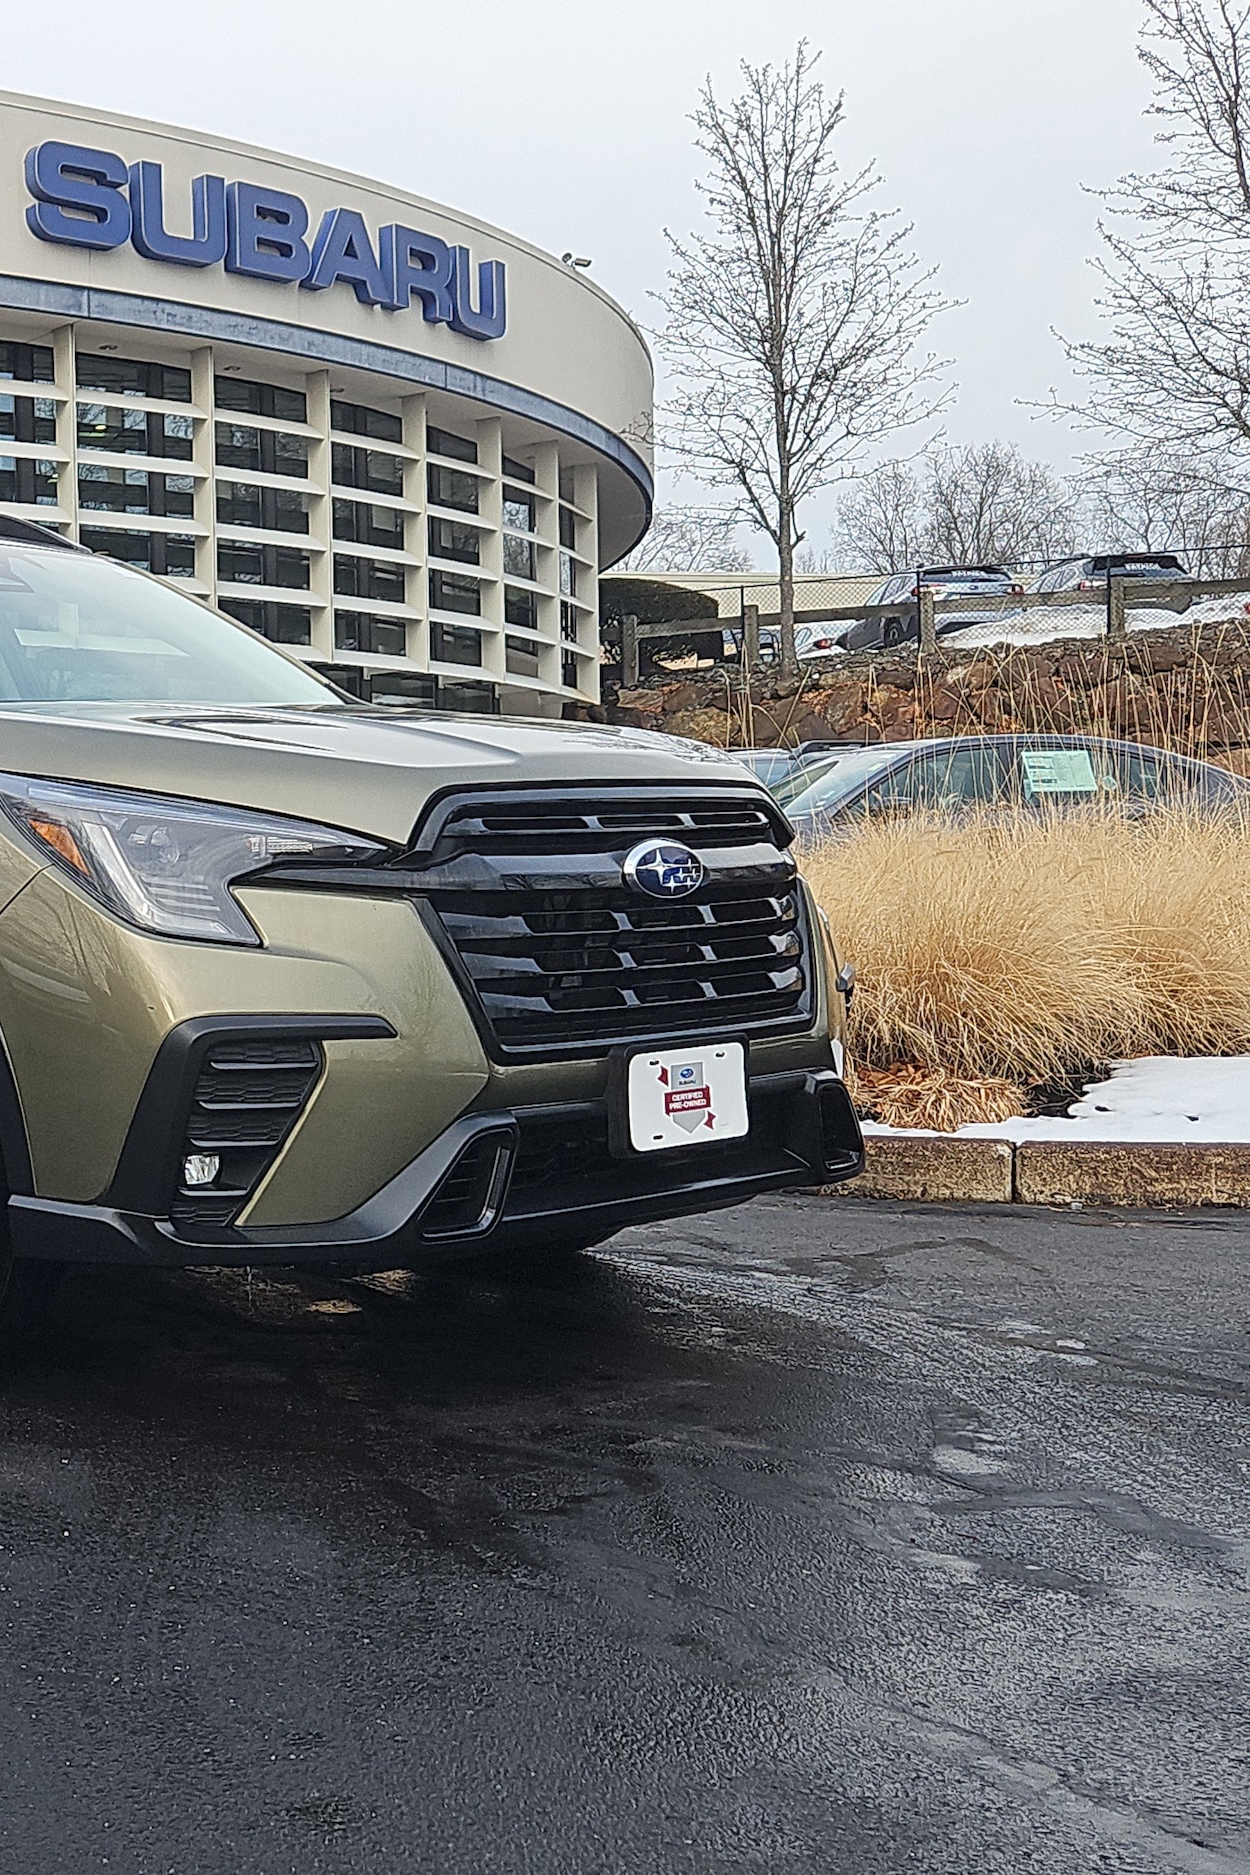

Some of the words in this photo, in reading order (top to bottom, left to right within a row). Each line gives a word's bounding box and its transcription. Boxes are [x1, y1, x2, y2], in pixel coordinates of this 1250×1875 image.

[25, 139, 507, 343] SUBARU
[671, 1091, 704, 1101] CERTIFIED
[669, 1098, 707, 1110] PRE-OWNED
